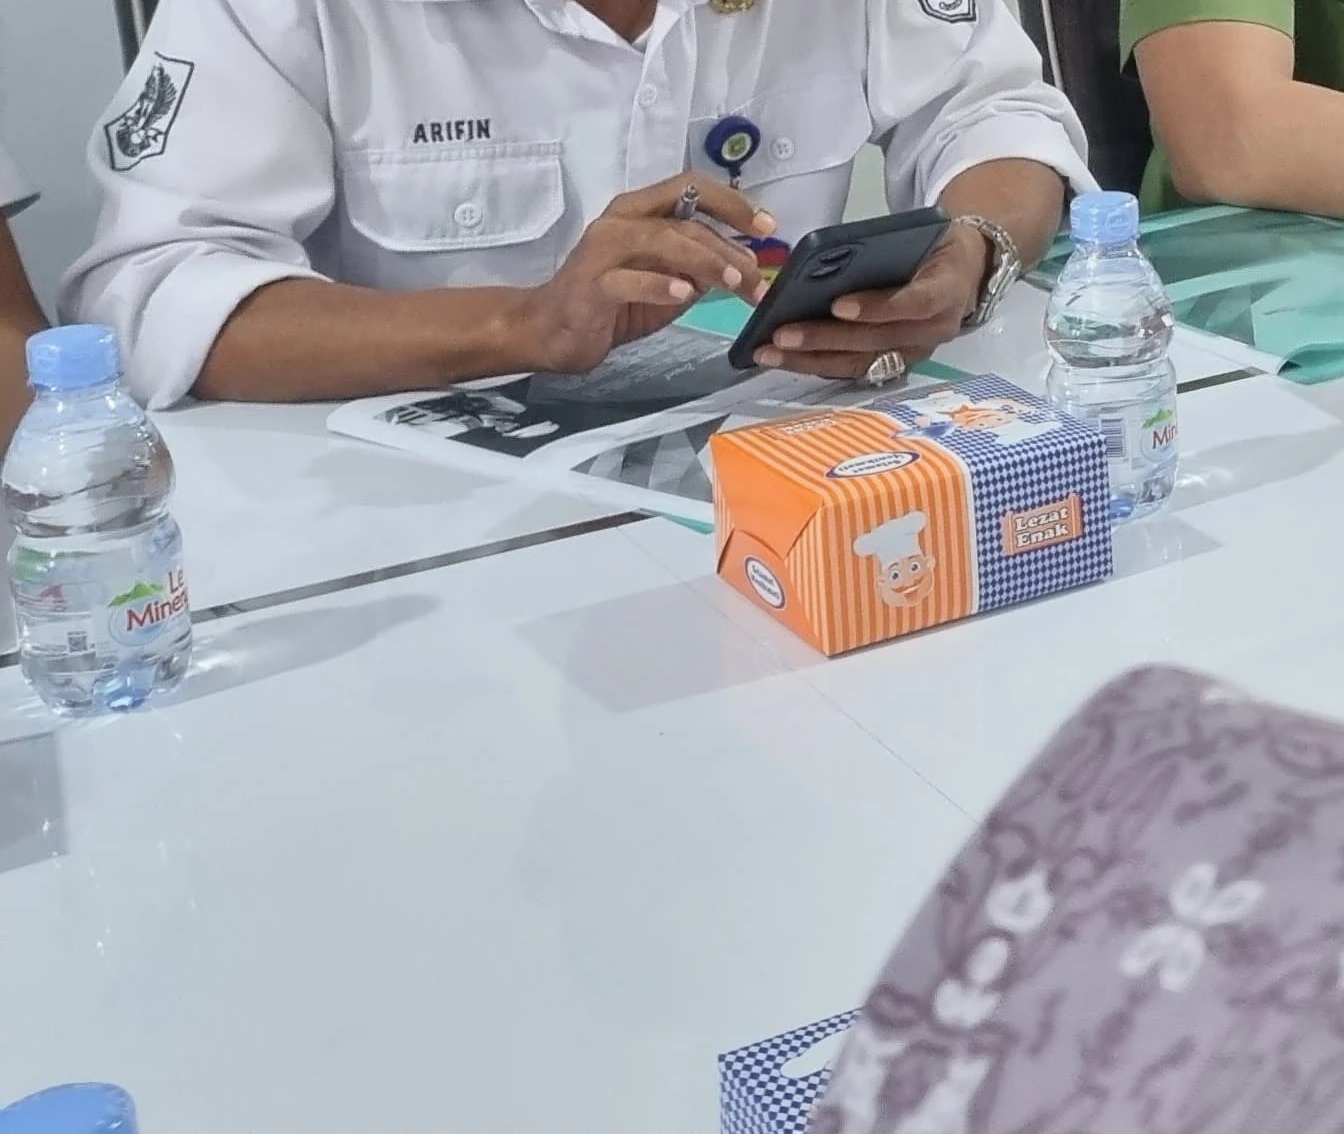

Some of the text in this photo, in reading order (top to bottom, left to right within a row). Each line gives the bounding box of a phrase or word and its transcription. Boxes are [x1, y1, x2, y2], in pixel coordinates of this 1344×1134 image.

[413, 118, 491, 143] ARIFIN
[1015, 507, 1069, 531] Lezat
[1016, 524, 1069, 548] Enak
[168, 570, 184, 594] Le
